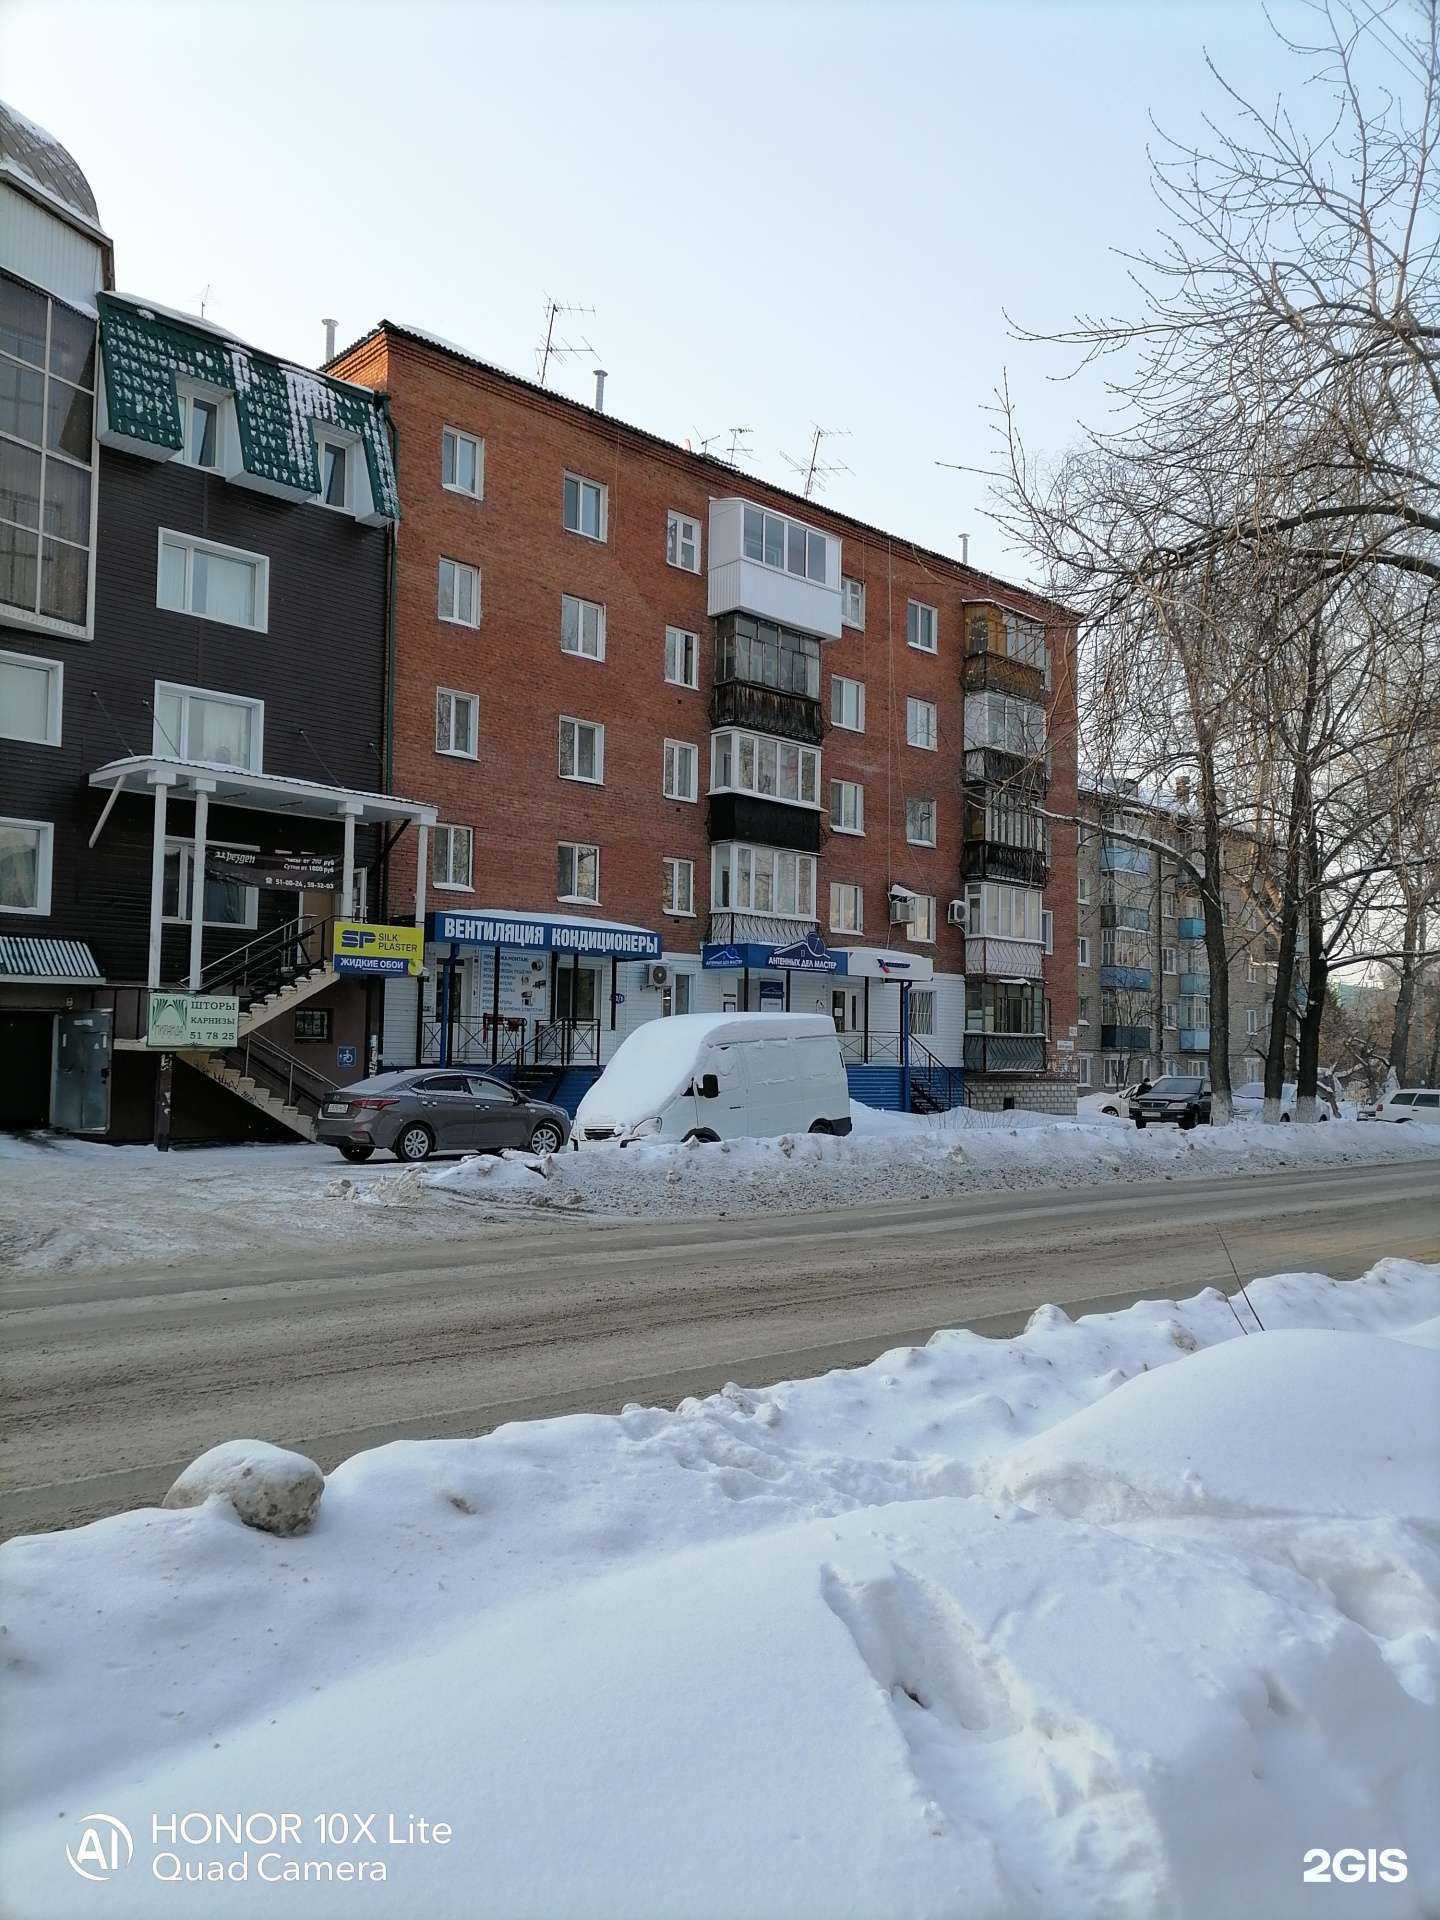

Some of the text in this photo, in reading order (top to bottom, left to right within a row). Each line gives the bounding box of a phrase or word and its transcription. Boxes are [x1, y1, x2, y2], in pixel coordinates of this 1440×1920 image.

[341, 930, 376, 949] SP
[378, 932, 398, 942] SILK
[444, 917, 658, 954] ВЕНТИЛЯЦИЯ КОНДИЦИОНЕРЫ
[378, 942, 418, 952] PLASTER
[340, 957, 404, 969] ЖИДКИЕ ОБОИ
[768, 956, 837, 970] АНТЕННЫХ ДЕЛ МАСТЕР
[191, 1001, 236, 1011] ШТОРЫ
[190, 1016, 235, 1025] КАРНИЗЫ
[189, 1031, 201, 1040] 51
[206, 1031, 219, 1040] 78
[221, 1032, 235, 1041] 25
